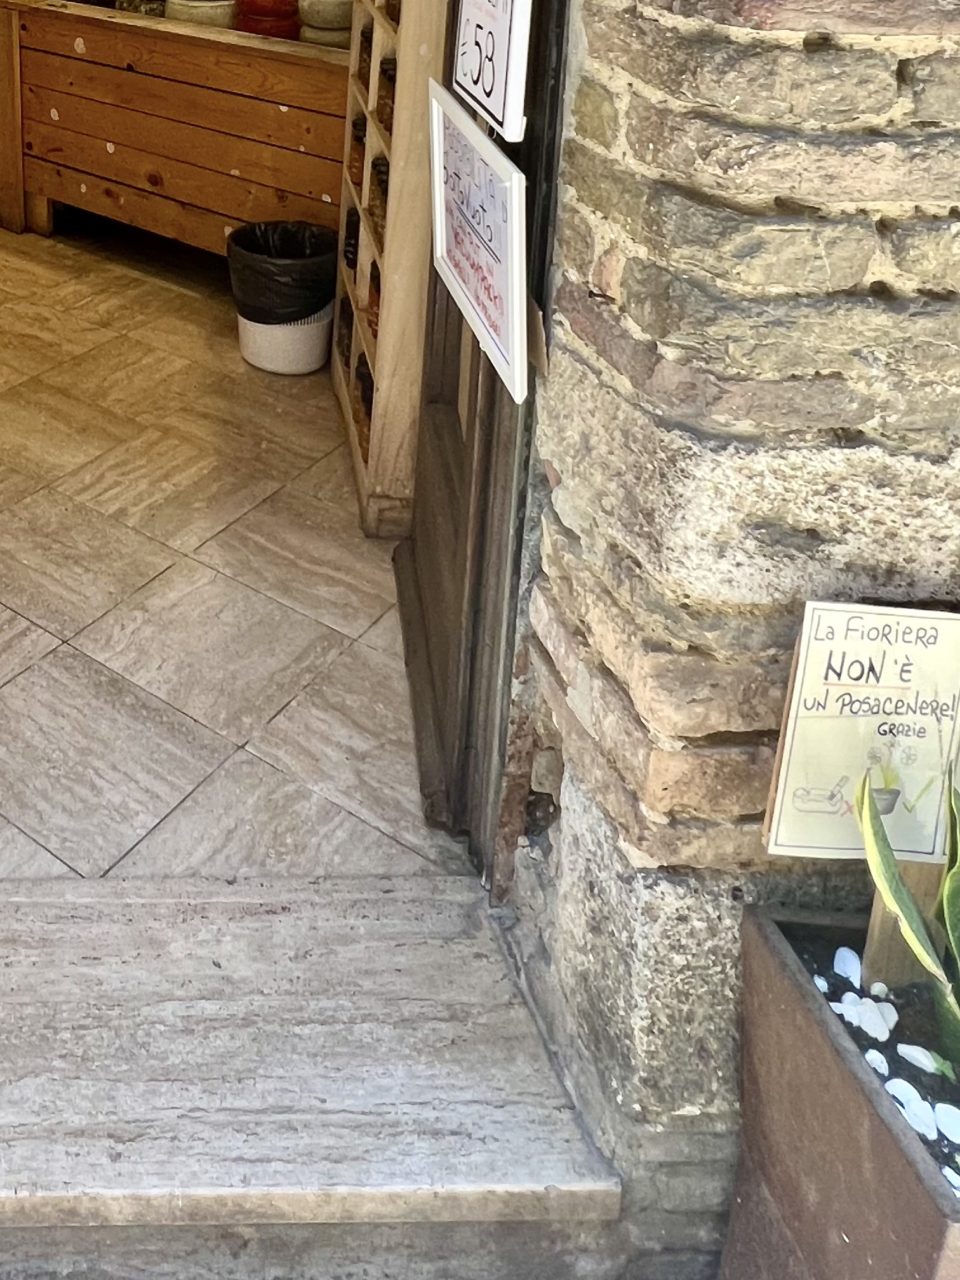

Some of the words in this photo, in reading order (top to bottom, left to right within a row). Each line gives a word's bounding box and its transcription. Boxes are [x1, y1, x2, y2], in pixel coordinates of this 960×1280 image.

[471, 23, 496, 99] 58
[814, 615, 835, 642] La
[824, 650, 886, 684] NON
[803, 689, 829, 711] UN
